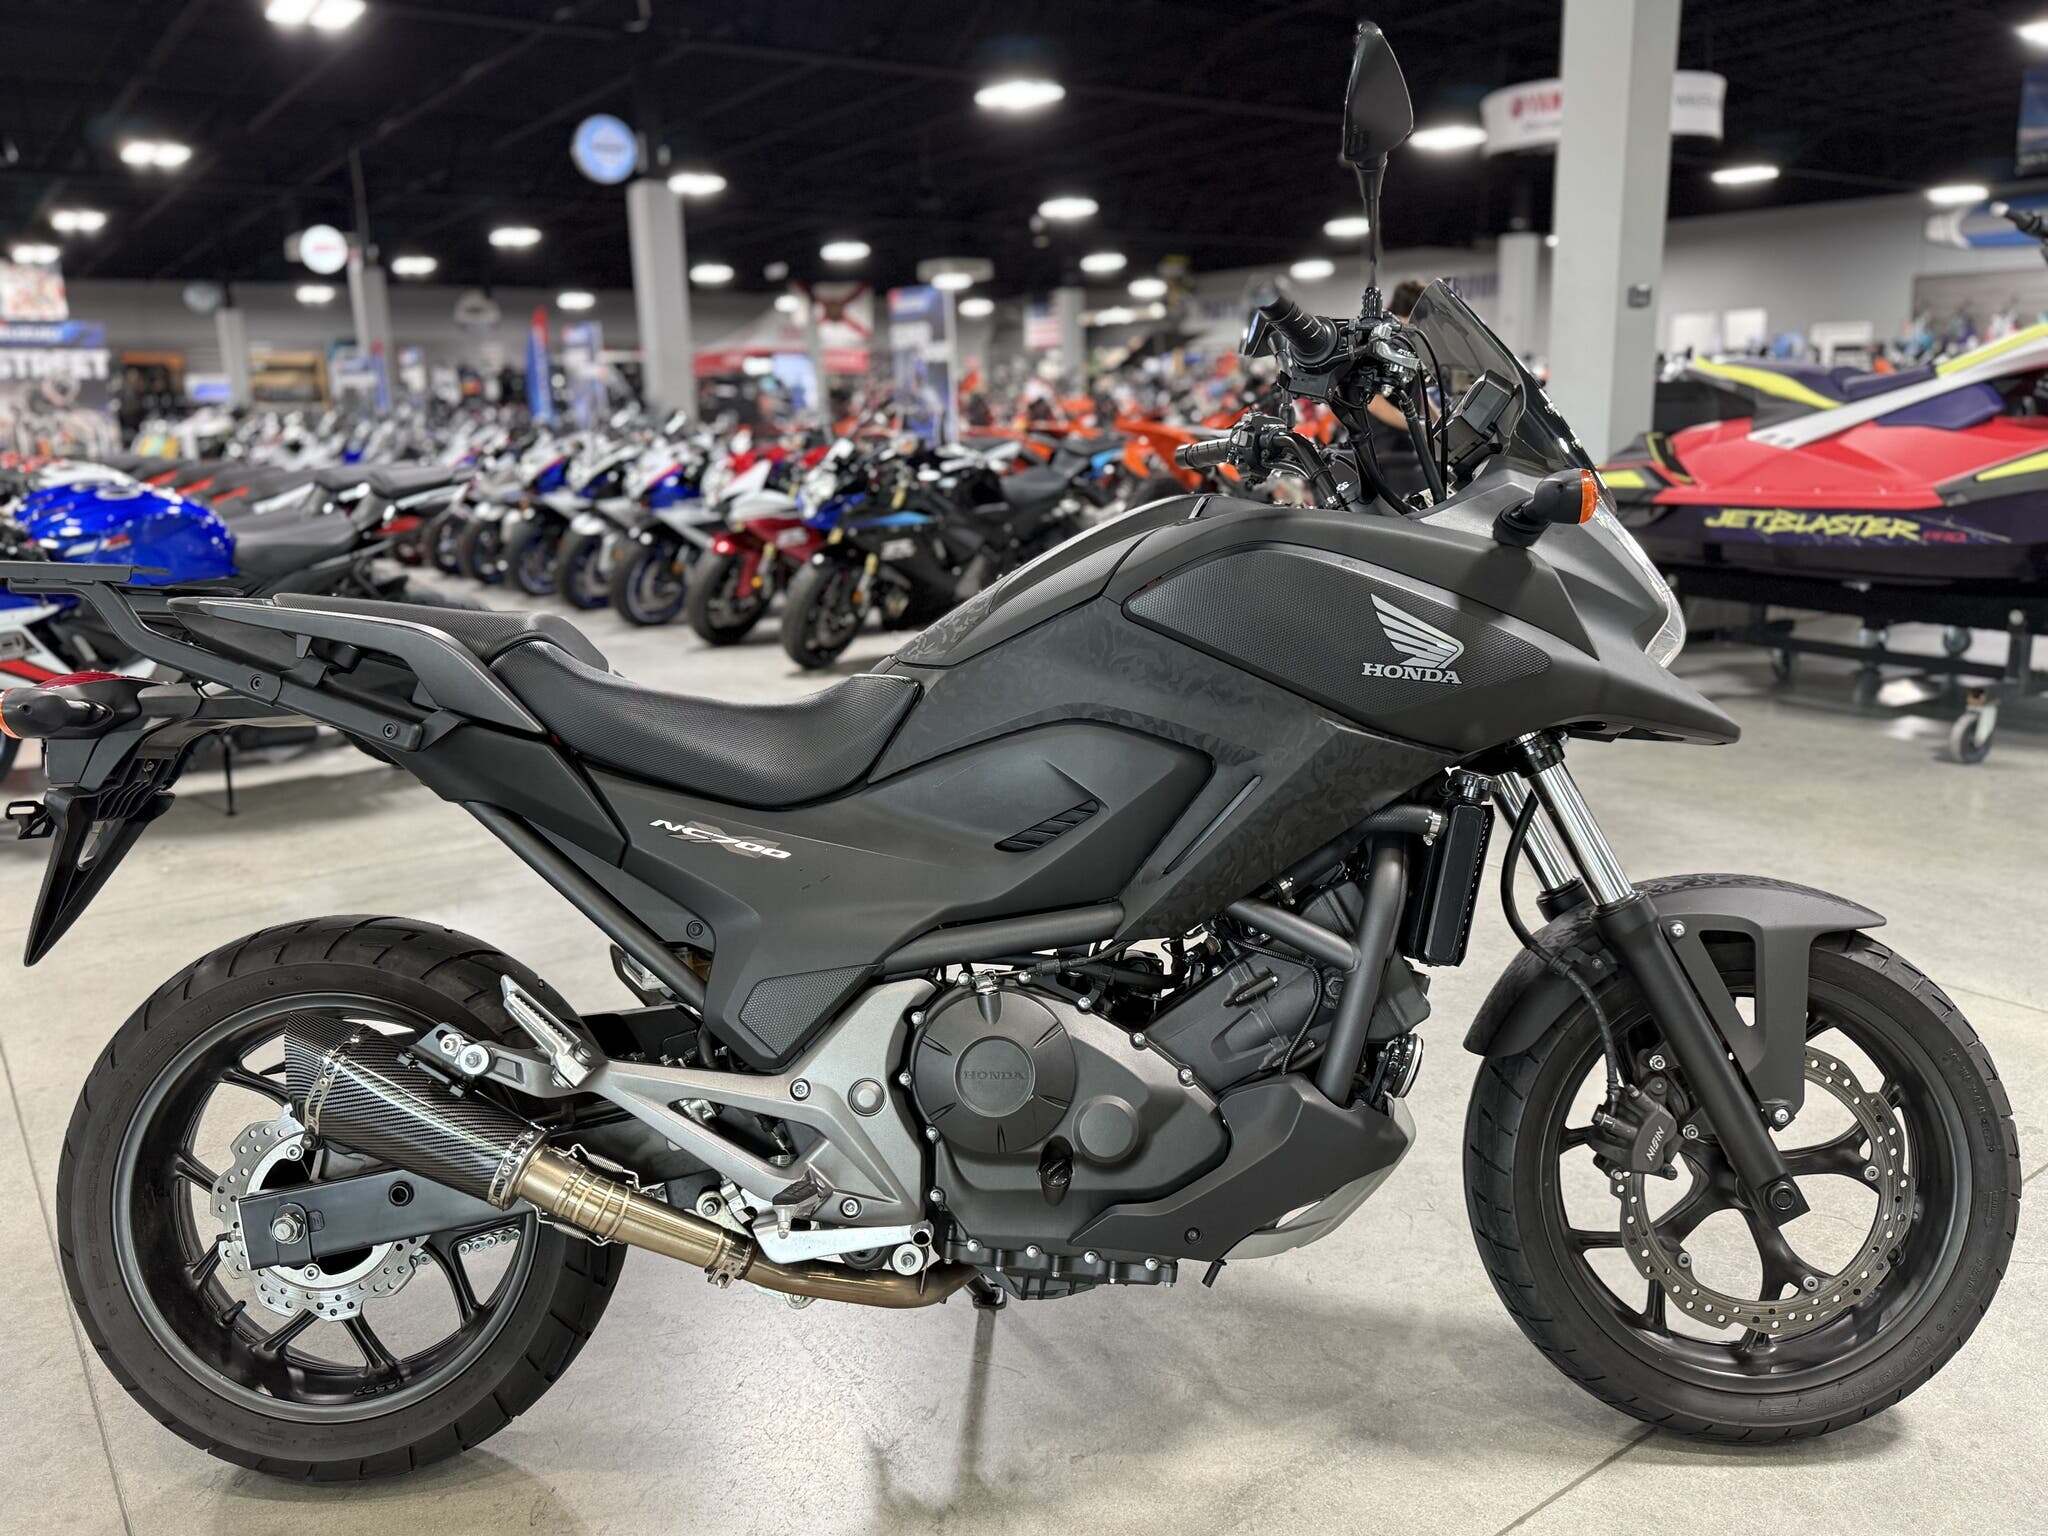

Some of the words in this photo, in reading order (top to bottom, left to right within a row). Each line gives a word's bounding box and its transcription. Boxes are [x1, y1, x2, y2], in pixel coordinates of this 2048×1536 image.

[1704, 508, 1921, 542] JETBLASTER
[1361, 662, 1462, 685] HONDA
[962, 1070, 1025, 1081] HONDA
